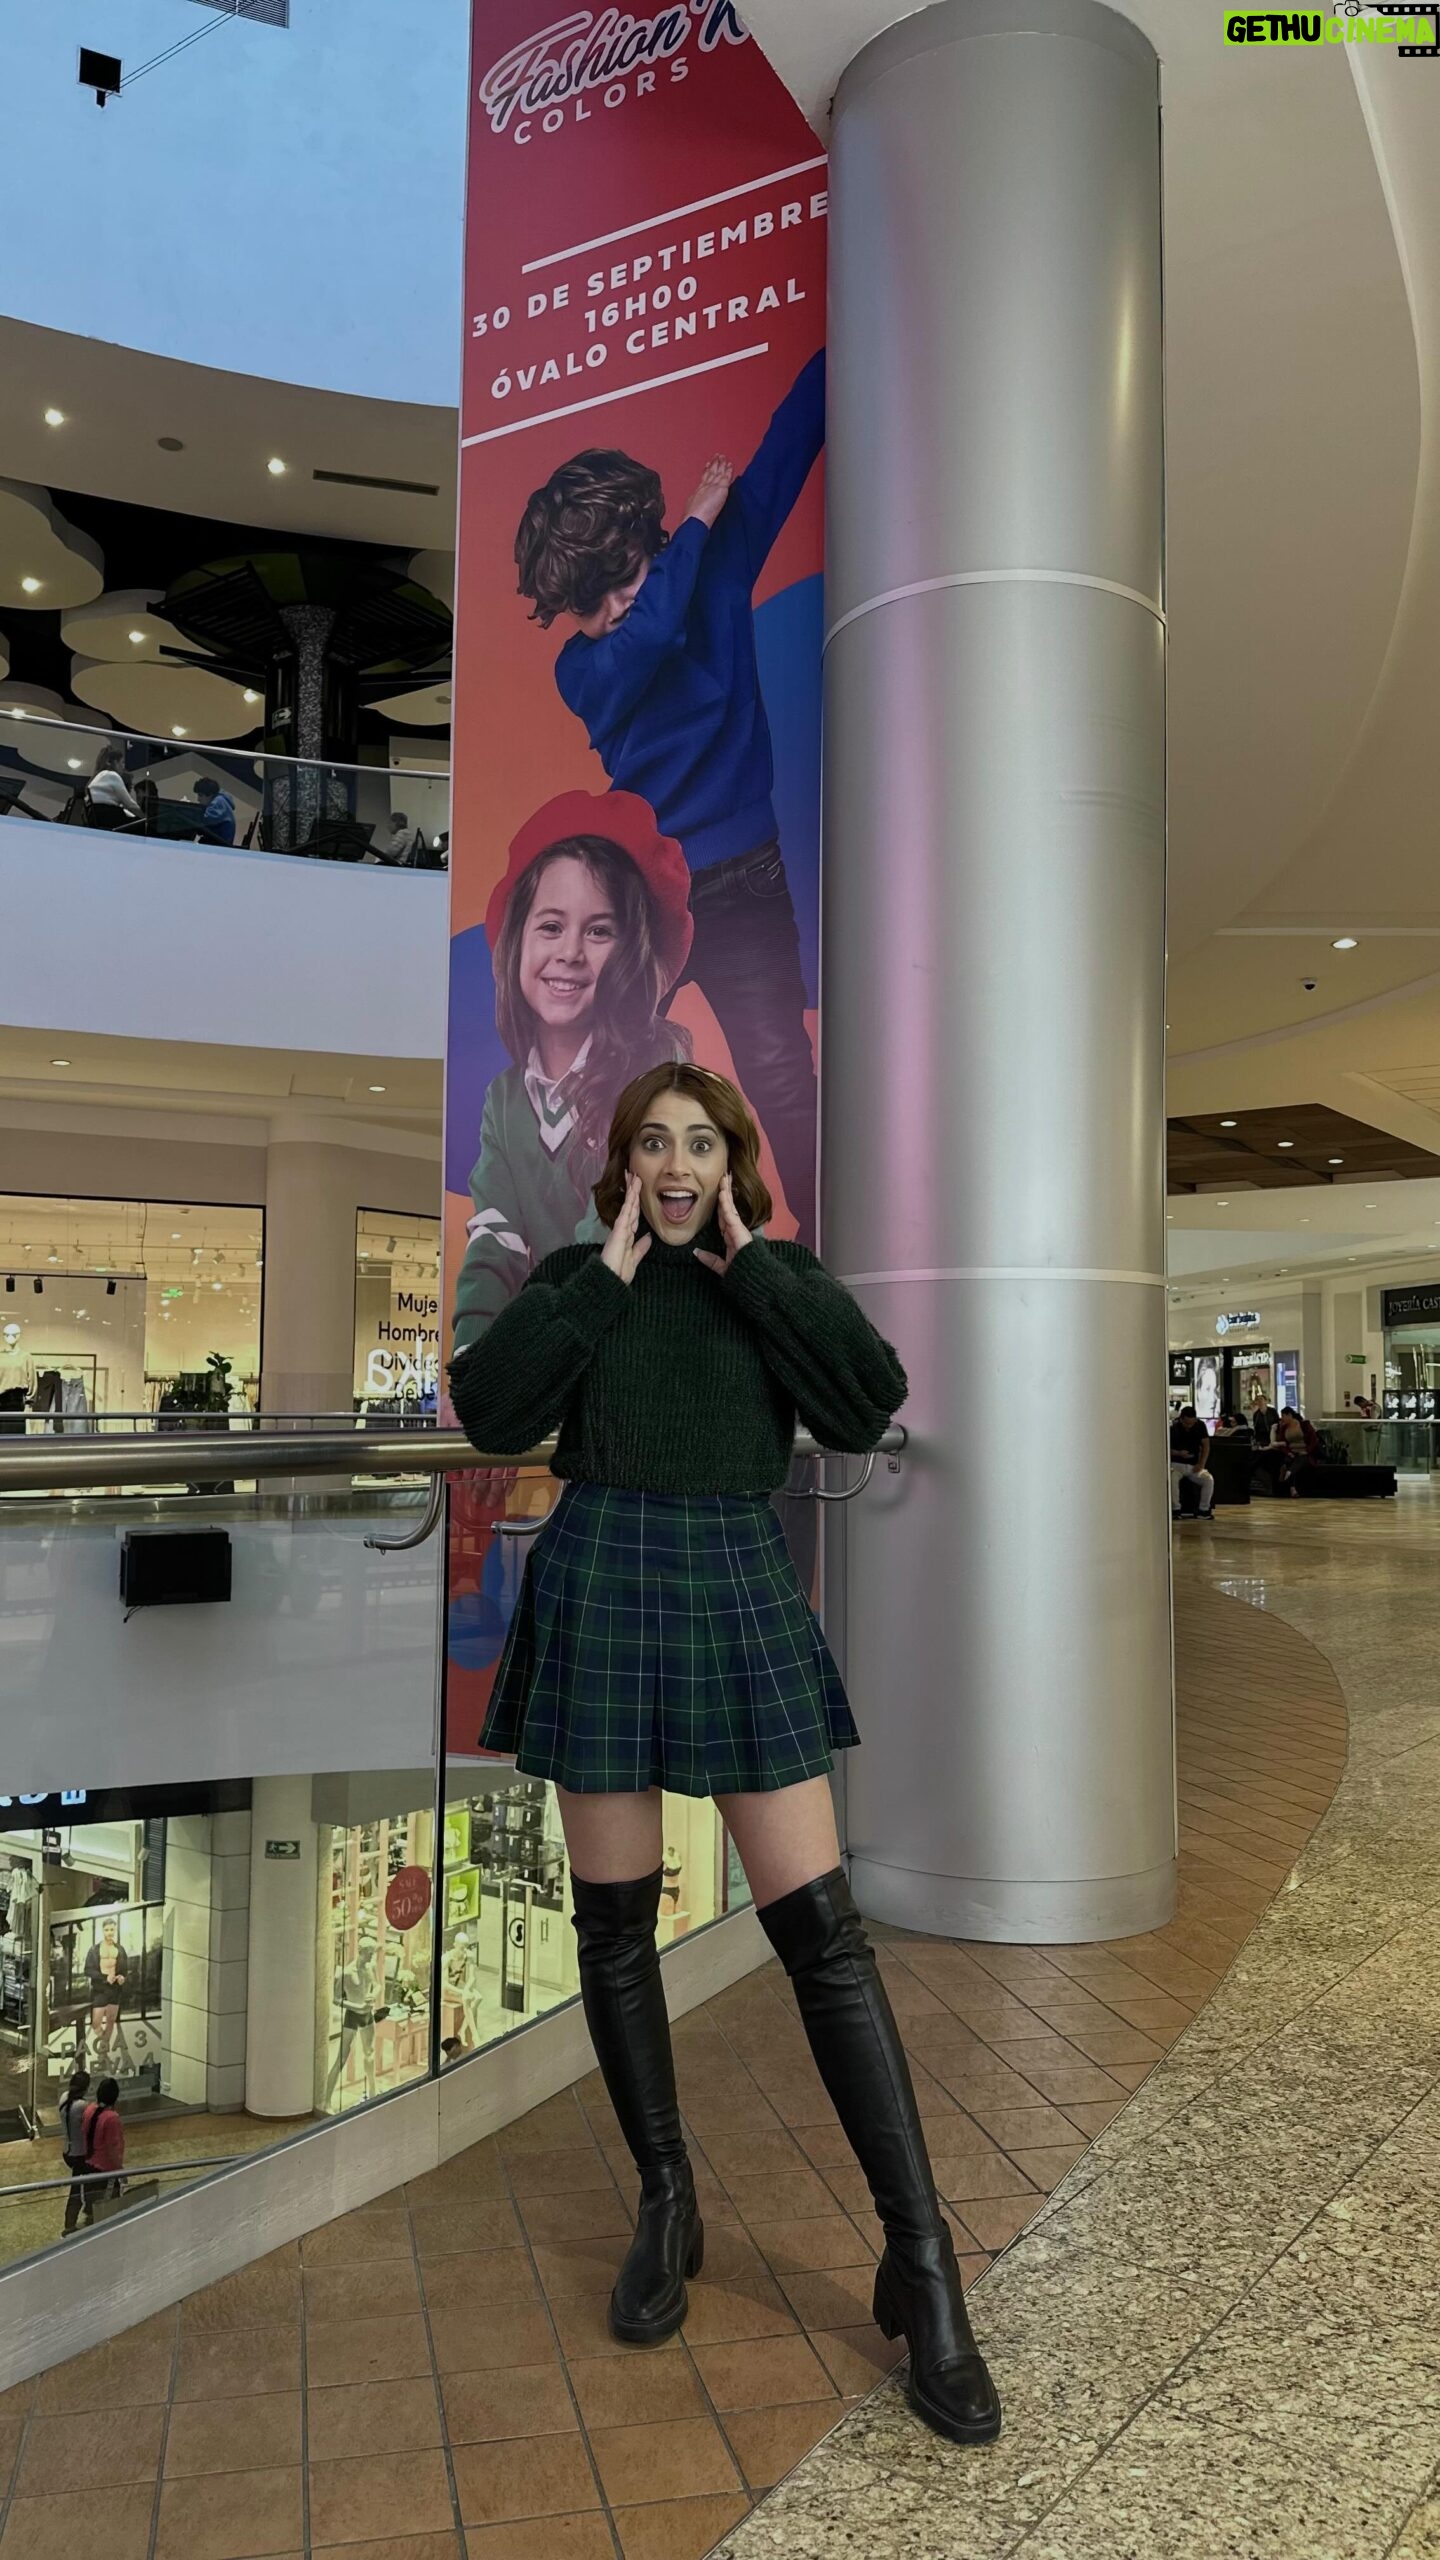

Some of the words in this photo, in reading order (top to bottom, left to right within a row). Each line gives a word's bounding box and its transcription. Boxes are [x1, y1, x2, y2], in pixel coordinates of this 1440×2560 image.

[480, 7, 690, 132] Fashion
[513, 56, 689, 145] COLORS
[472, 306, 510, 338] 30
[528, 283, 569, 319] DE
[587, 191, 828, 297] SEPTIEMBRE
[584, 276, 698, 333] 16H00
[490, 343, 608, 400] ÓVALO
[626, 278, 806, 355] CENTRAL
[133, 2030, 148, 2049] 3
